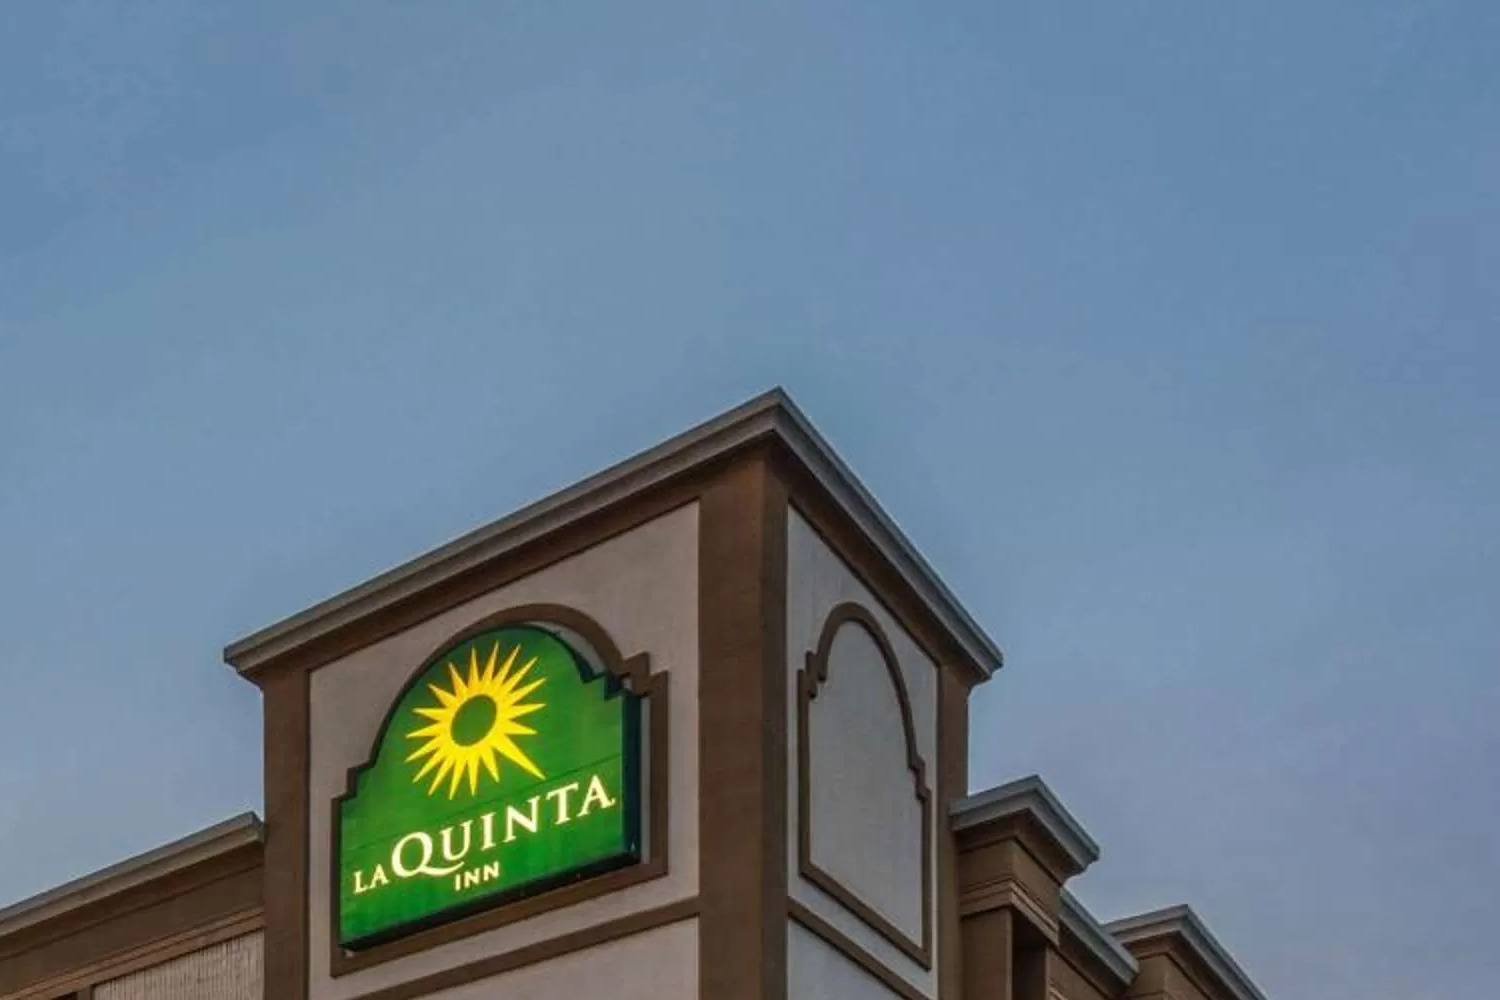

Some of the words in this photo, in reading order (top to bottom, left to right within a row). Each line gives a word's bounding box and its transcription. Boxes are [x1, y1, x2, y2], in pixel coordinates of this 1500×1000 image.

[353, 865, 389, 893] LA
[391, 775, 615, 878] QUINTA
[454, 861, 499, 891] INN
